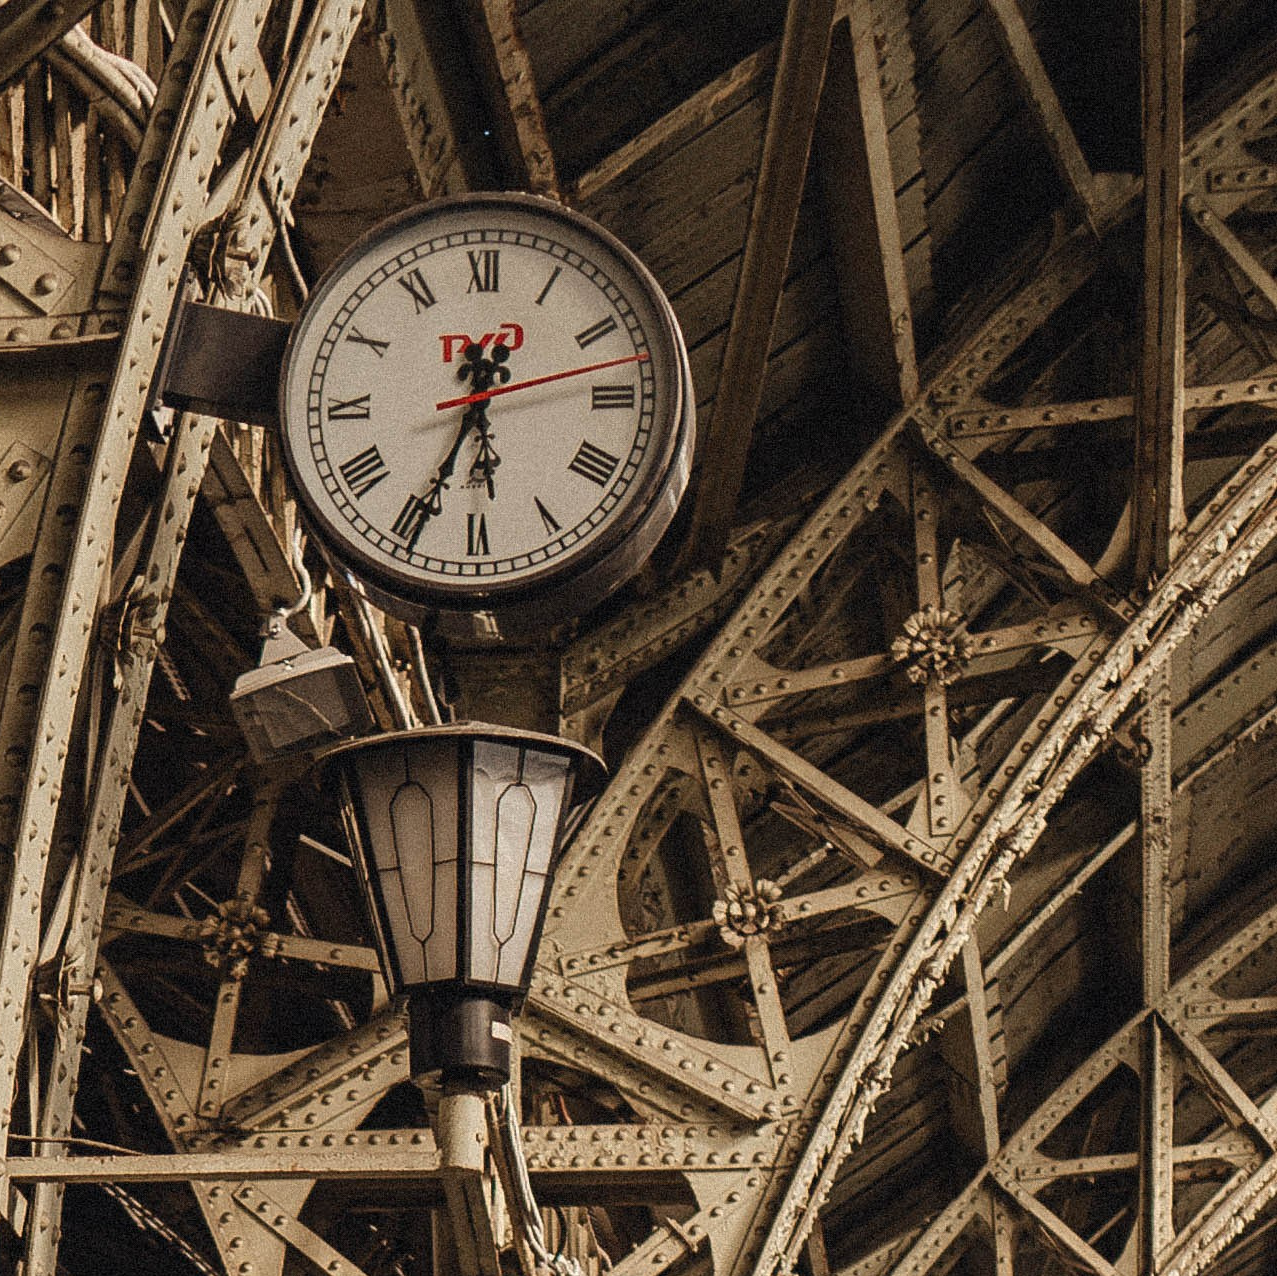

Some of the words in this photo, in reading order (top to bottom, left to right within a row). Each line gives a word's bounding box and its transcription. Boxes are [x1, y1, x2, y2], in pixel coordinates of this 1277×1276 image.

[467, 250, 499, 293] XII
[535, 267, 561, 305] I
[398, 269, 436, 314] XI
[347, 325, 390, 357] X
[575, 315, 617, 349] II
[328, 393, 370, 421] IX
[592, 385, 634, 411] III
[339, 445, 391, 500] VIII
[567, 440, 619, 487] IIII
[534, 496, 561, 534] V
[467, 514, 489, 556] VI
